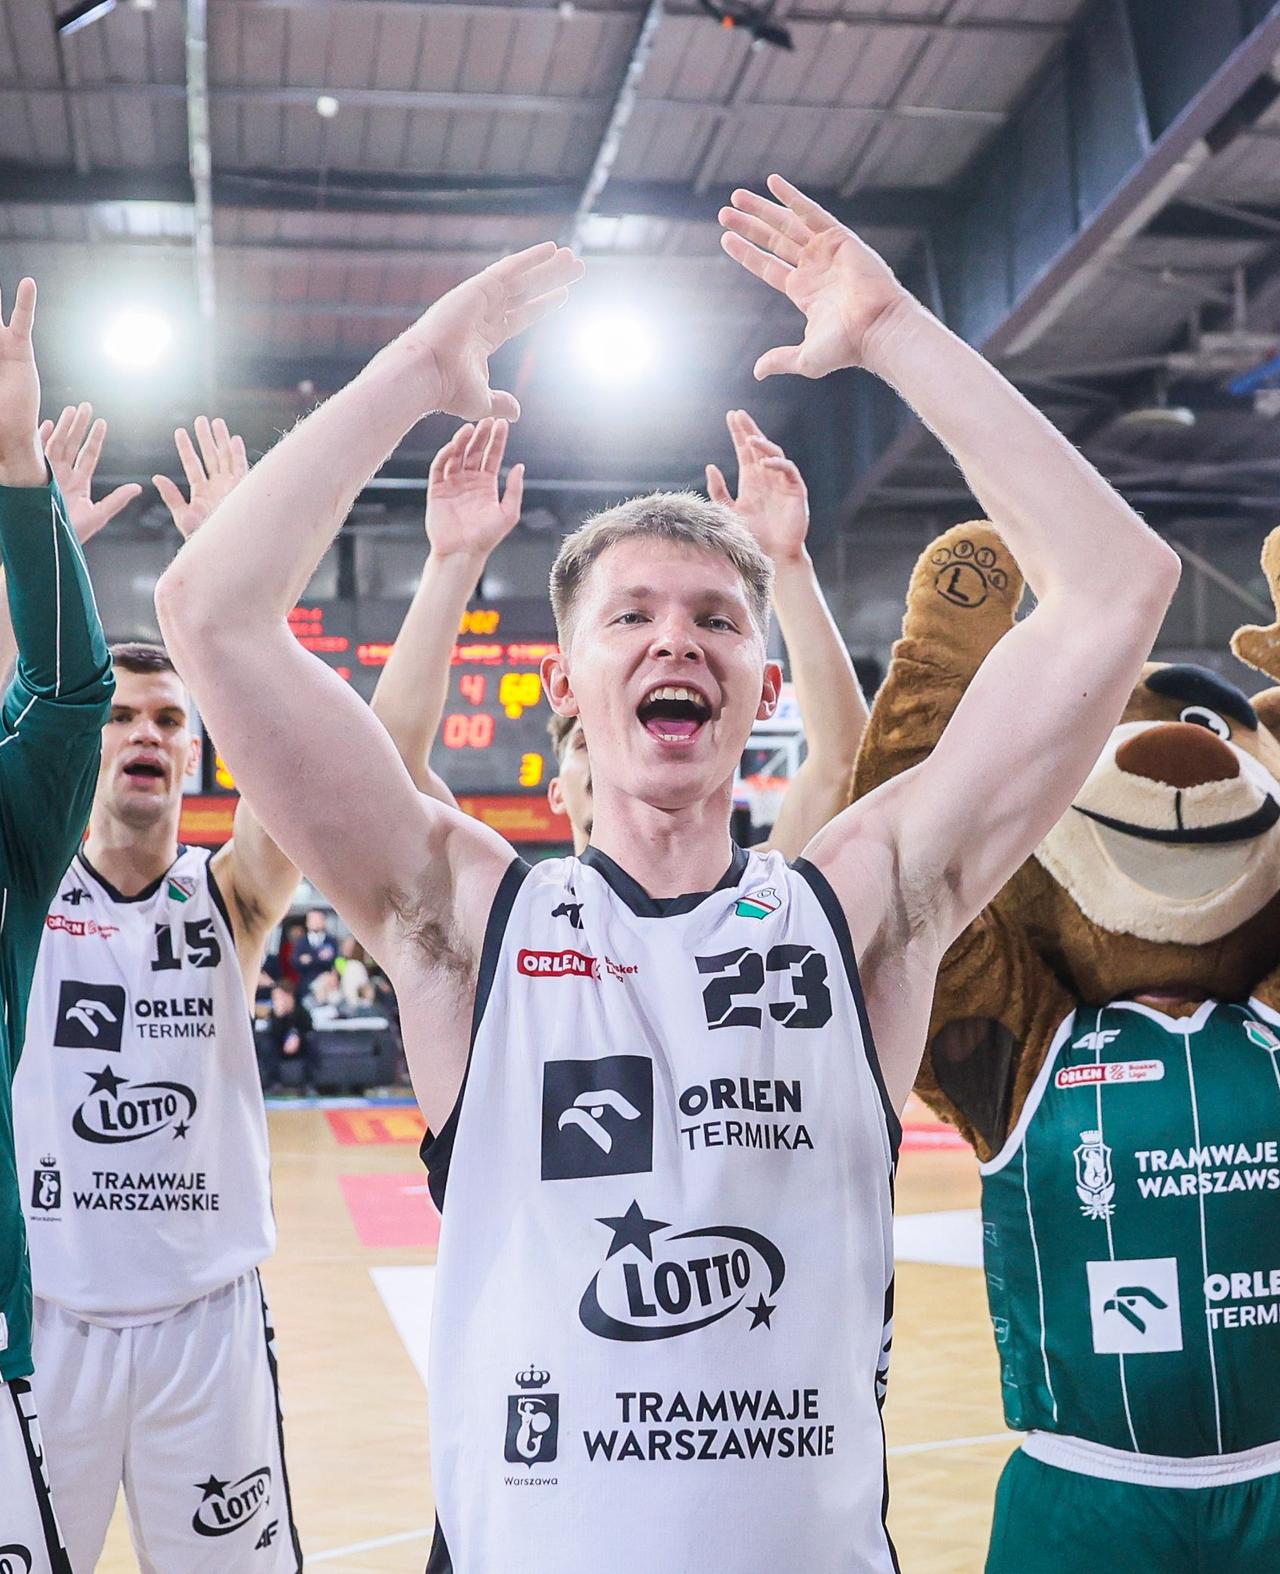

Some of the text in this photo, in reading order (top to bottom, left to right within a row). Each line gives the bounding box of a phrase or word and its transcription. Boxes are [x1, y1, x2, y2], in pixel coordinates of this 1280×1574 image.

[151, 918, 221, 971] 15
[522, 953, 586, 972] ORLEN
[695, 944, 833, 1031] 23
[135, 998, 213, 1018] ORLEN
[136, 1022, 216, 1039] TERMIKA
[1060, 1068, 1103, 1084] ORLEN
[99, 1094, 177, 1130] LOTTO
[678, 1077, 802, 1116] ORLEN
[681, 1120, 814, 1150] TERMIKA
[1135, 1141, 1278, 1172] TRAMWAJE
[92, 1172, 206, 1190] TRAMWAJE
[73, 1192, 220, 1212] WARSZAWSKIE
[623, 1248, 751, 1317] LOTTO
[616, 1388, 819, 1423] TRAMWAJE
[583, 1425, 835, 1461] WARSZAWSKIE
[504, 1476, 558, 1487] Warszawa
[211, 1478, 265, 1525] LOTTO
